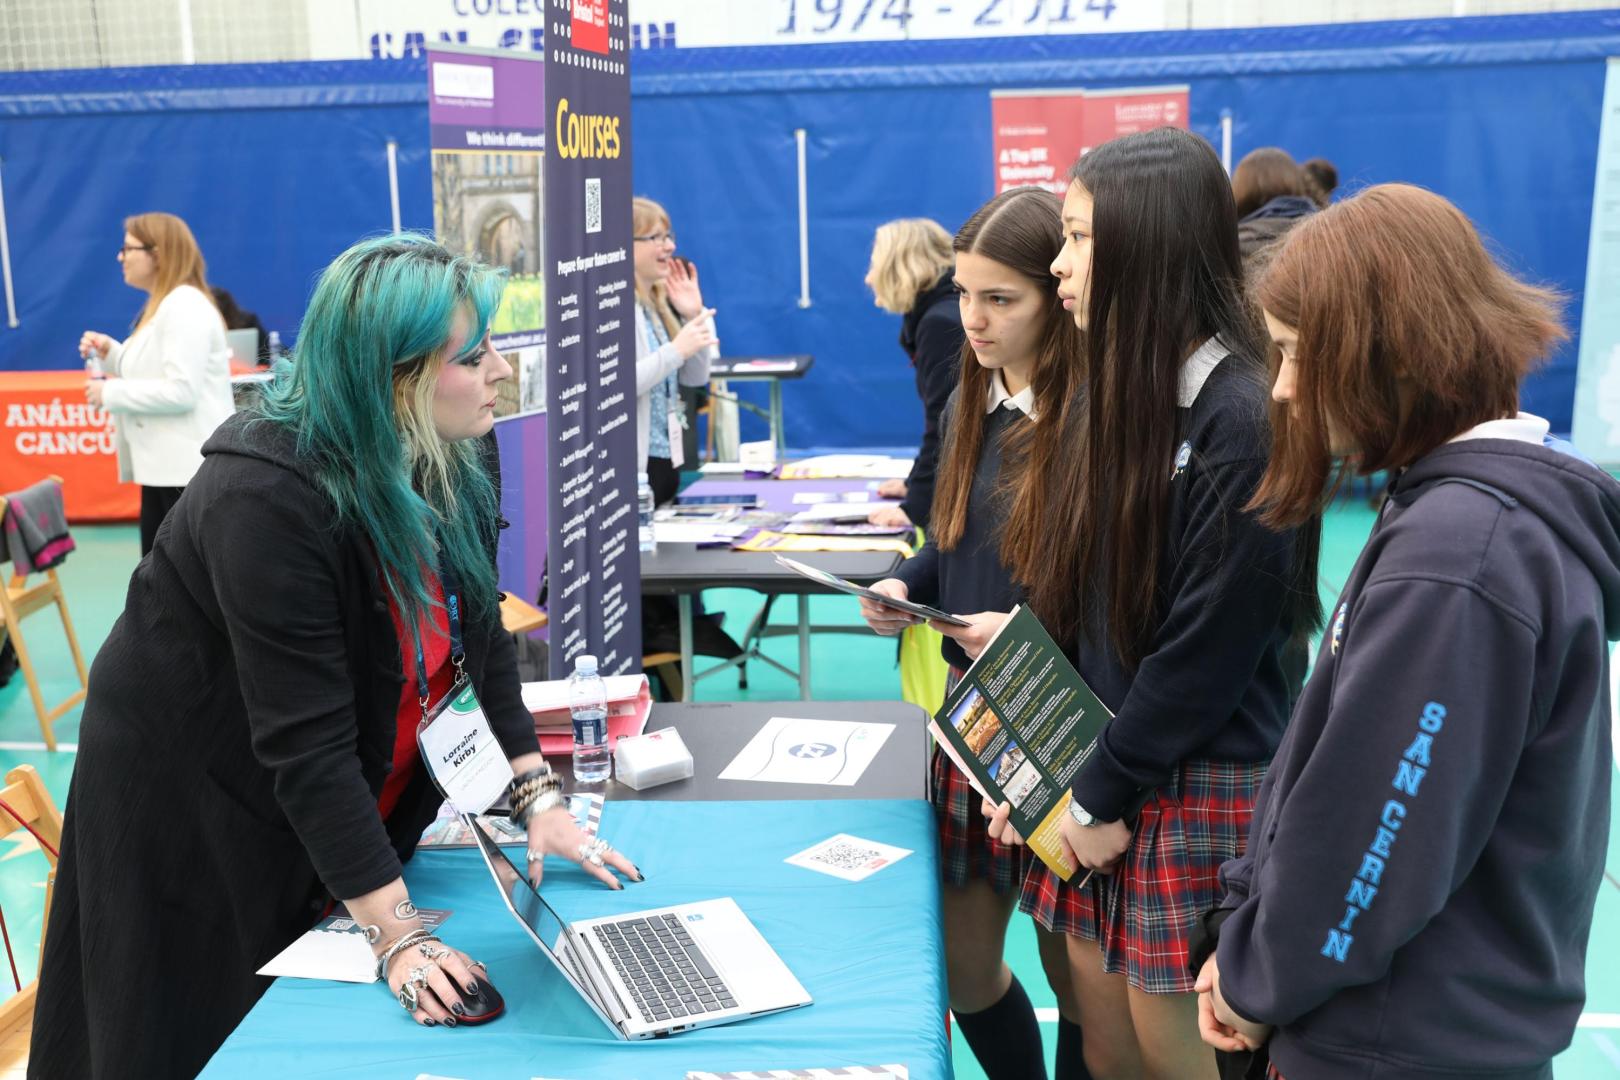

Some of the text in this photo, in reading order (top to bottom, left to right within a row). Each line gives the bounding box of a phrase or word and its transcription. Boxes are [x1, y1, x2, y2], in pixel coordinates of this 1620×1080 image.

[482, 131, 506, 146] think
[556, 97, 621, 160] Courses
[442, 728, 478, 763] Lorraine
[453, 744, 477, 768] Kirby
[1392, 700, 1447, 798] SAN
[1320, 798, 1407, 965] CERNIN
